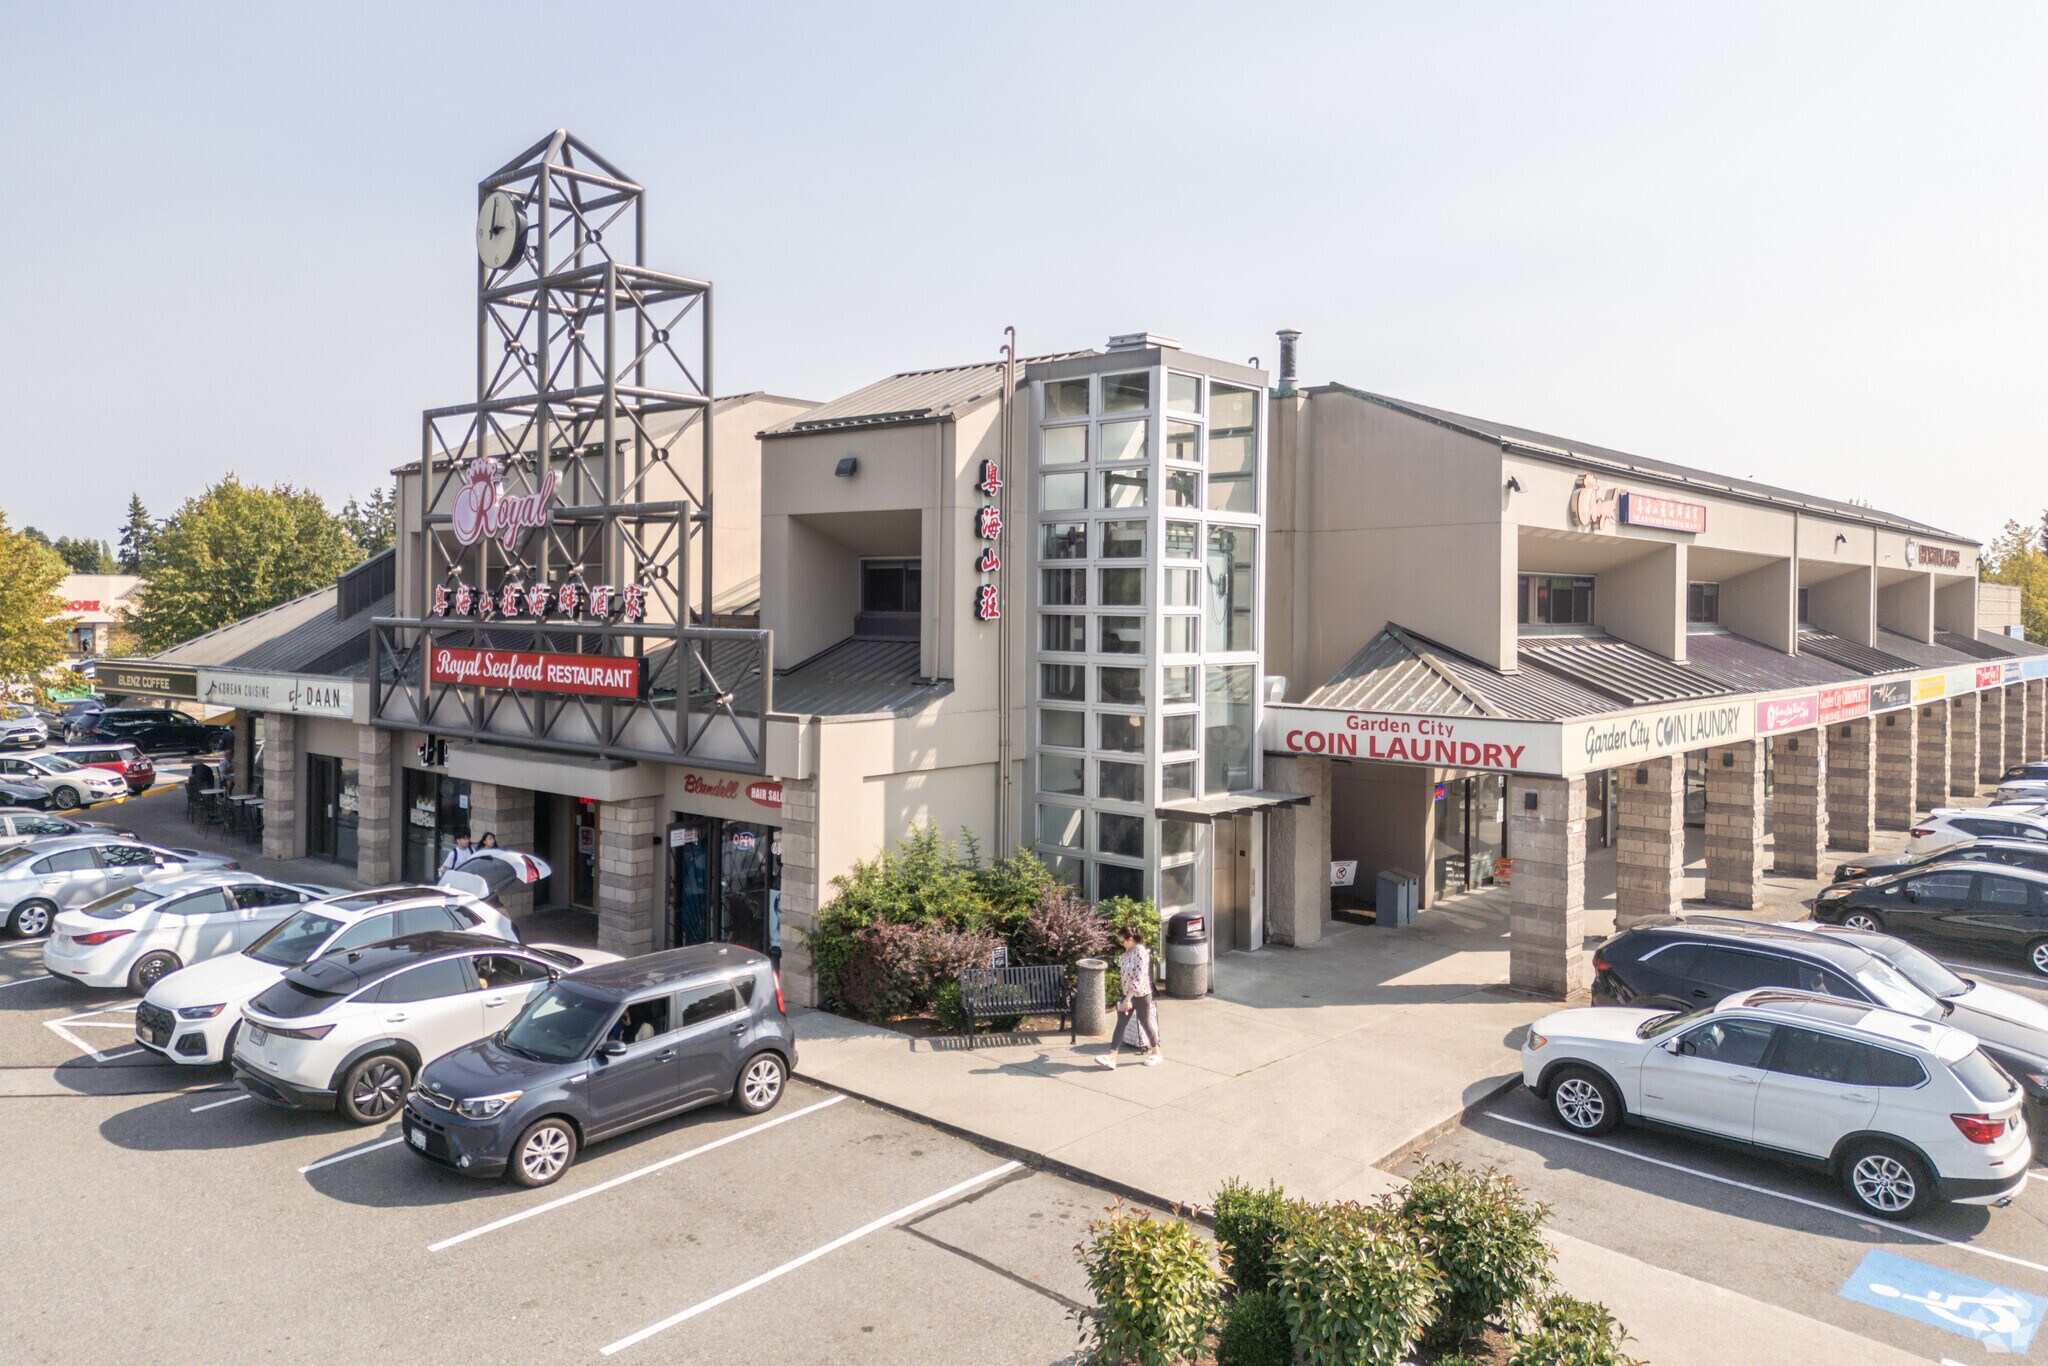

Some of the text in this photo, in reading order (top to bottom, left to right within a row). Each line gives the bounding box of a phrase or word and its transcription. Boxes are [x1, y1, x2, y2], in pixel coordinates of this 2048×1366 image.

[453, 469, 560, 550] Royal
[1632, 514, 1702, 531] SEAFOOD RESTAURANT
[436, 650, 632, 688] Royal Seafood RESTAURANT
[118, 674, 170, 689] BLENZ COFFEE
[218, 682, 270, 699] KOREAN CUISINE
[306, 686, 340, 708] DAAN
[1346, 715, 1454, 738] Garden City
[1585, 706, 1741, 763] Garden City COIN LAUNDRY
[1286, 730, 1526, 769] COIN LAUNDRY
[684, 774, 739, 800] Blundell
[751, 788, 783, 803] HAIR SAL
[733, 832, 755, 850] OPEN
